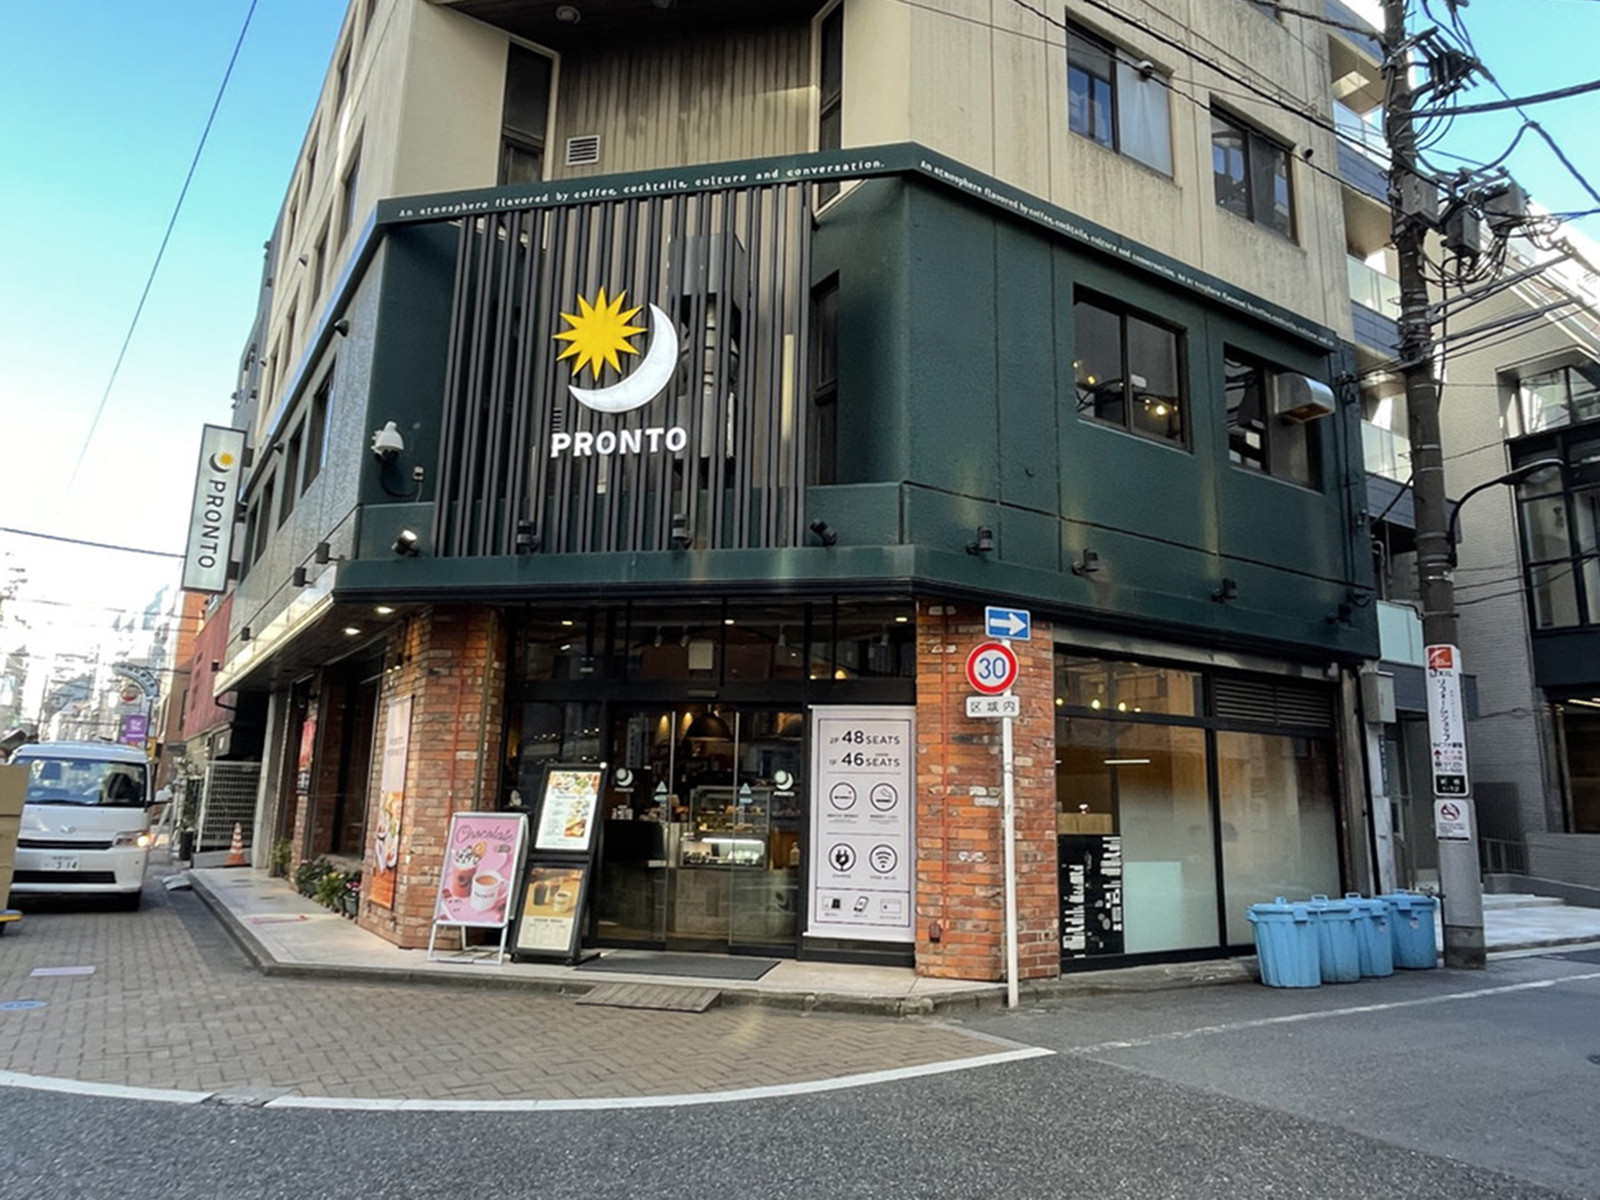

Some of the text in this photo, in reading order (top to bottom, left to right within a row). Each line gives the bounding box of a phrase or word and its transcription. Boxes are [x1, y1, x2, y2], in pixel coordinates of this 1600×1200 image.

[920, 160, 933, 171] An
[419, 201, 488, 215] atmosphere
[495, 193, 549, 207] flavored
[556, 192, 569, 202] by
[695, 172, 748, 187] culture
[755, 168, 779, 181] and
[787, 158, 886, 177] conversation.
[551, 427, 687, 458] PRONTO
[198, 479, 226, 569] PRONTO
[978, 657, 1006, 680] 30
[970, 701, 1016, 713] 区域内
[841, 730, 864, 745] 48
[865, 735, 900, 745] SEATS
[841, 752, 864, 767] 46
[865, 758, 900, 768] SEATS
[456, 824, 513, 844] Chocolate
